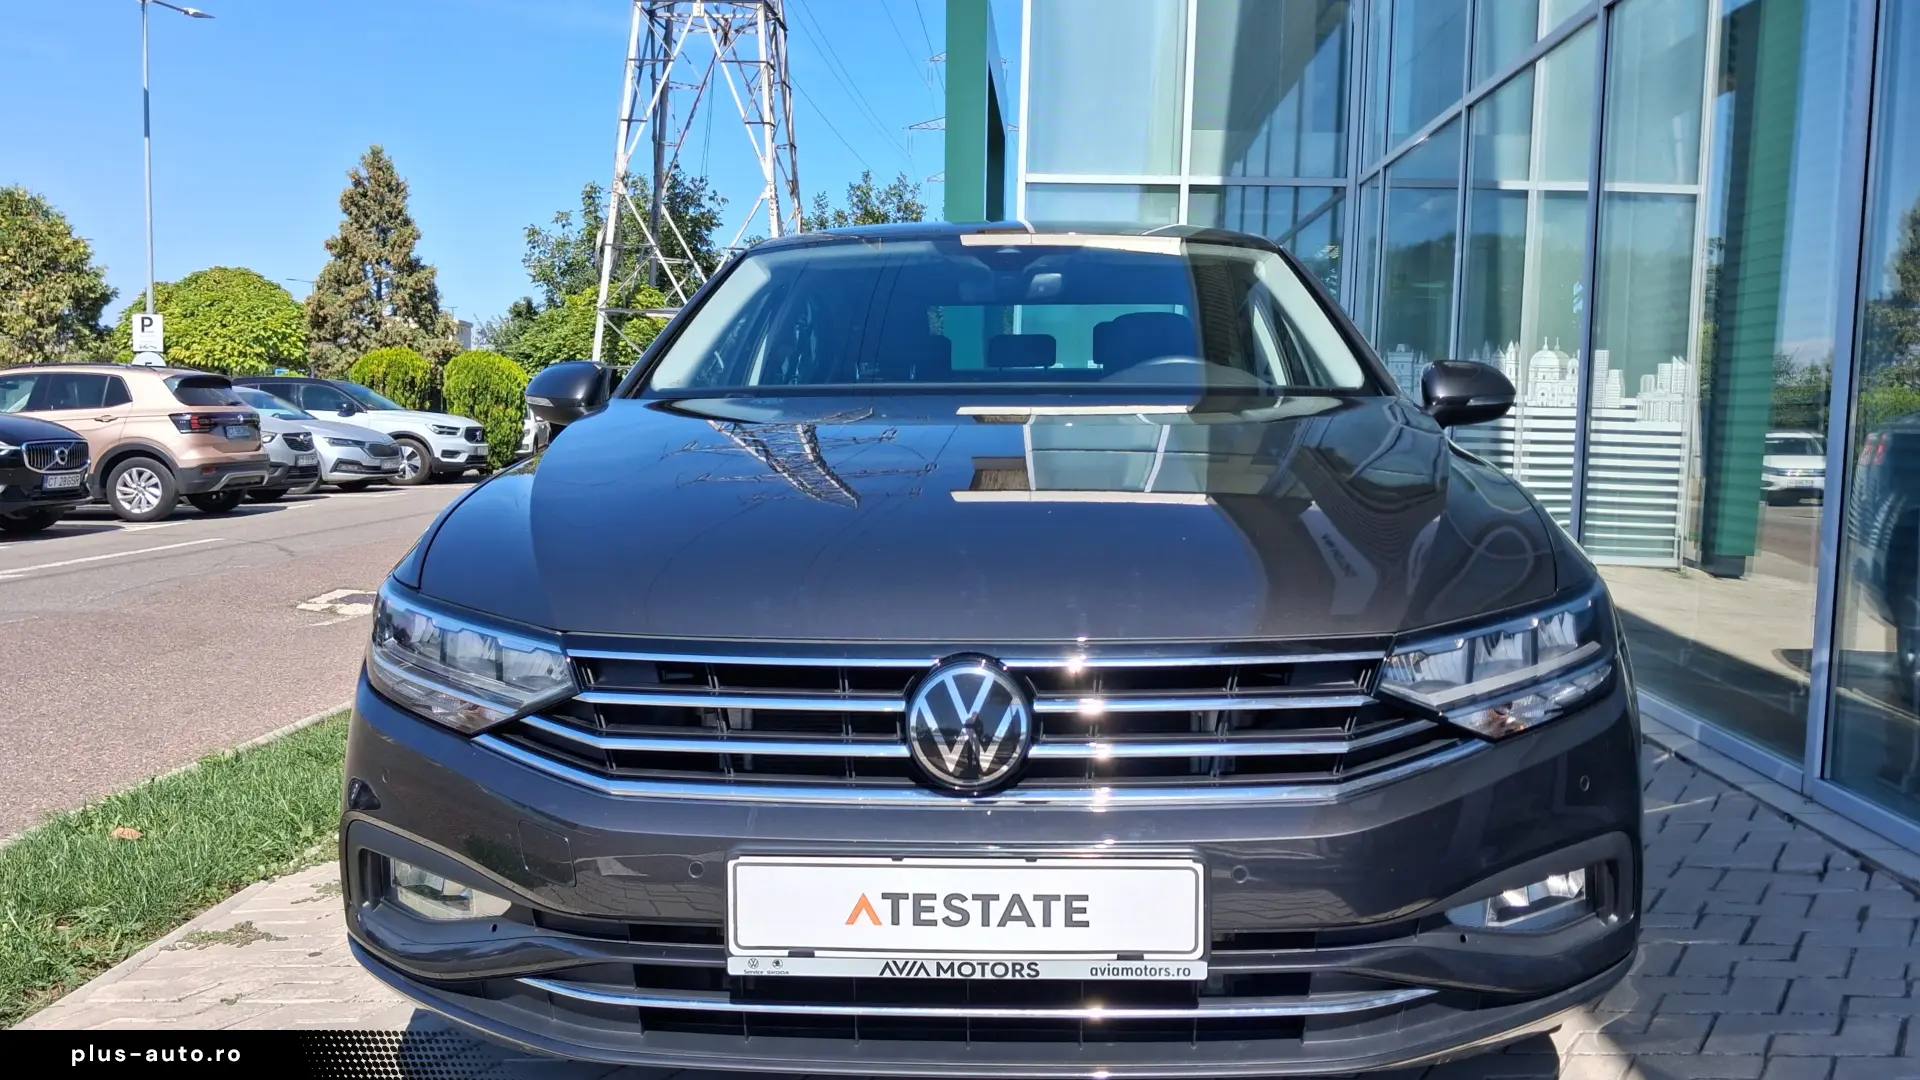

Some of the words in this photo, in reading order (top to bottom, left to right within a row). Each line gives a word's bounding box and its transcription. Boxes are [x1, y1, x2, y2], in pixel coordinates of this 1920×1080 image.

[141, 316, 153, 333] P
[48, 477, 58, 487] CT
[844, 892, 1090, 928] ATESTATE
[878, 960, 931, 977] AVIA
[936, 961, 1040, 978] MOTORS
[1090, 963, 1191, 977] aviamotors.ro
